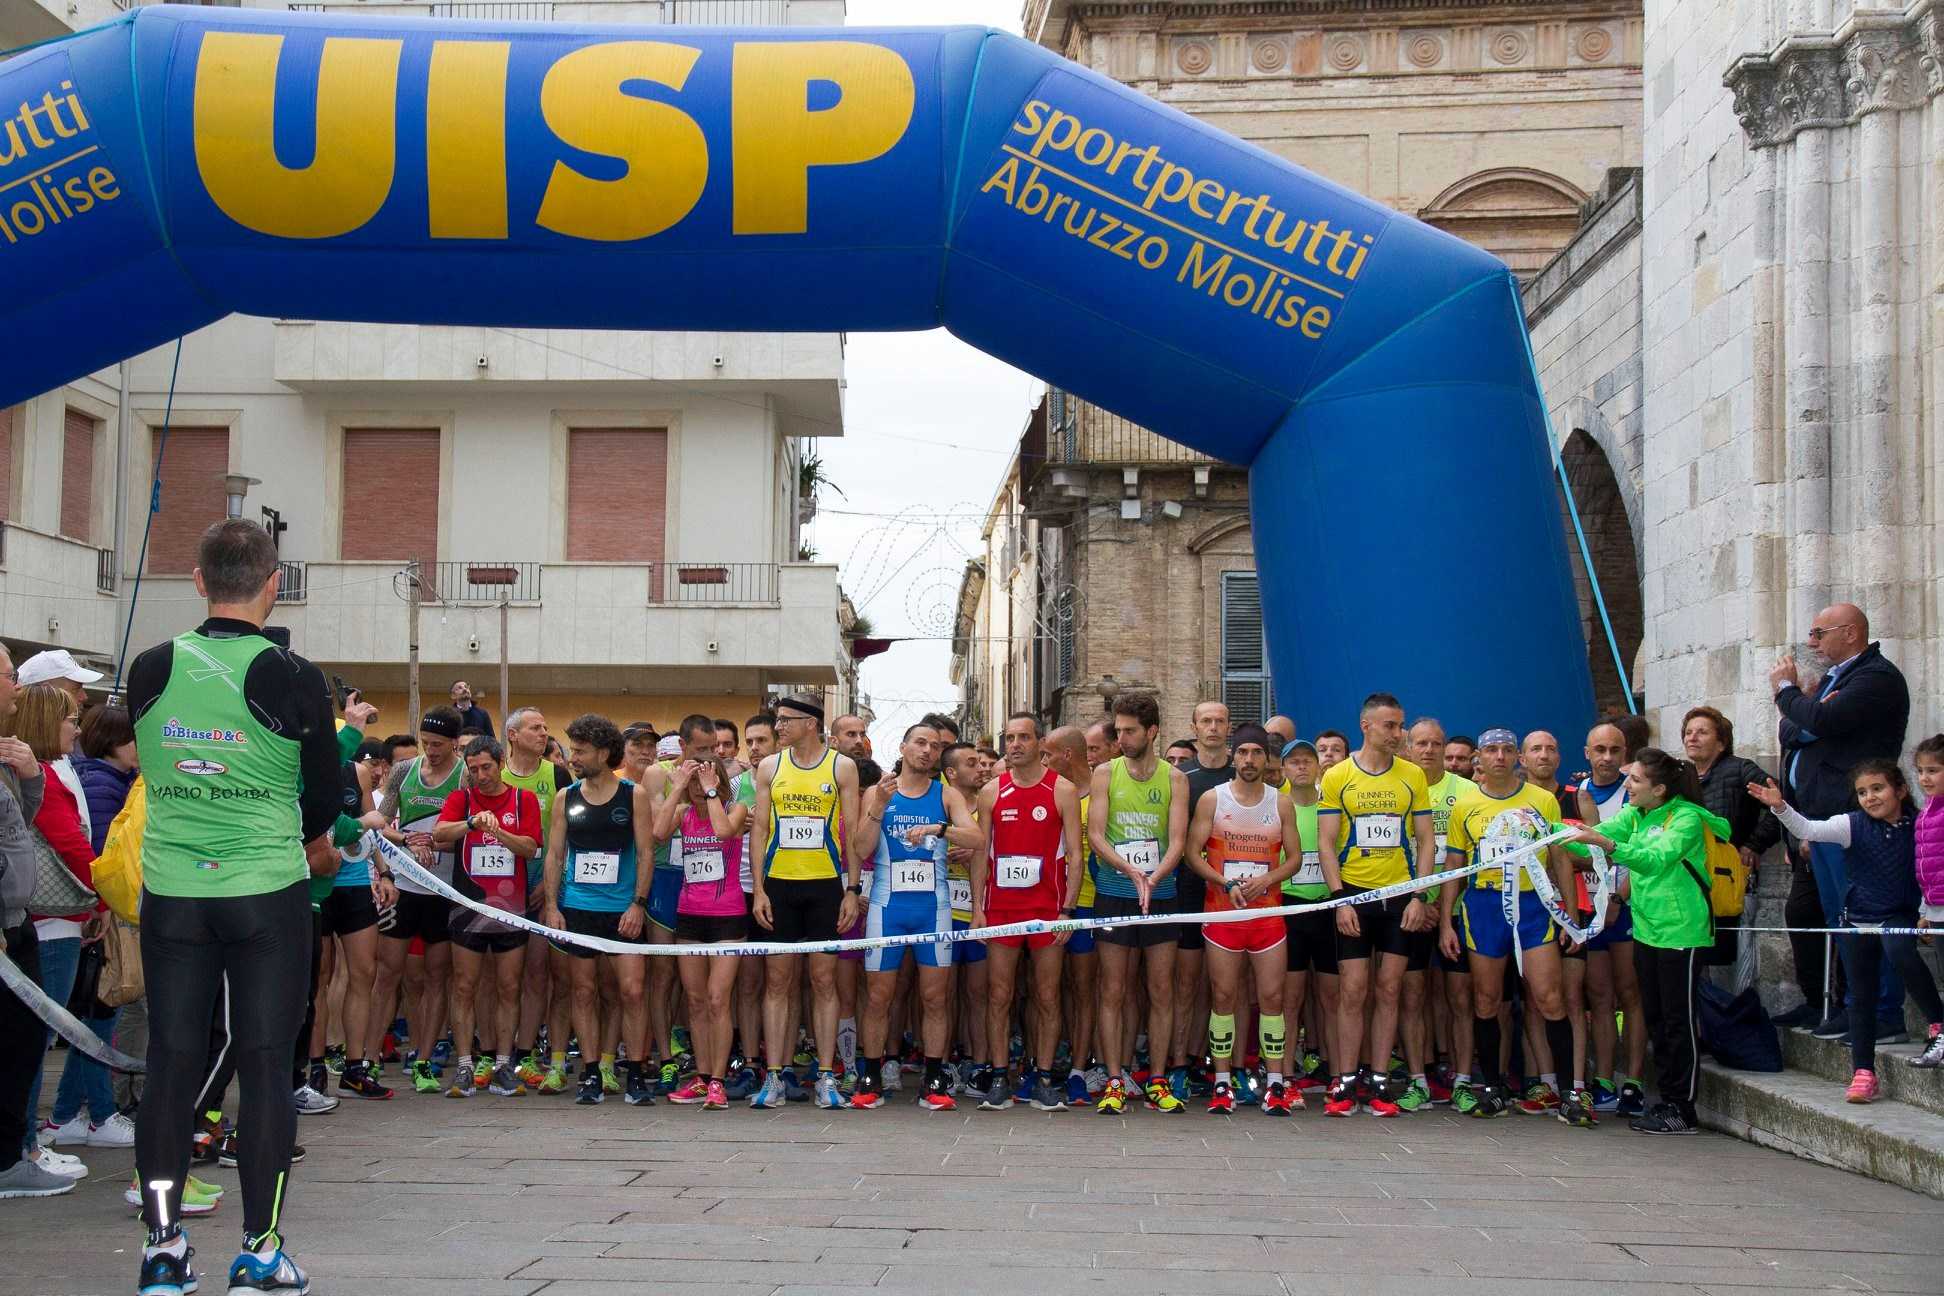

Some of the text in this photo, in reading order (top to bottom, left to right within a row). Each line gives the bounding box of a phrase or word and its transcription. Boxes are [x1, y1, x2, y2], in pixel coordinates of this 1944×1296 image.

[194, 31, 915, 241] UISP
[1013, 99, 1373, 280] sportpertutti
[0, 164, 121, 245] olise
[981, 157, 1332, 340] Abruzzo Molise
[782, 793, 822, 804] RUNNERS
[1357, 791, 1396, 800] RUNNERS
[1357, 800, 1397, 809] PESCARA
[893, 815, 930, 824] PODISTICA
[788, 827, 813, 840] 189
[1223, 830, 1268, 843] Progetto
[1366, 826, 1392, 839] 196
[480, 855, 504, 868] 135
[1126, 851, 1151, 865] 164
[582, 862, 608, 876] 257
[690, 860, 713, 875] 276
[1006, 867, 1029, 880] 150
[899, 870, 925, 884] 146
